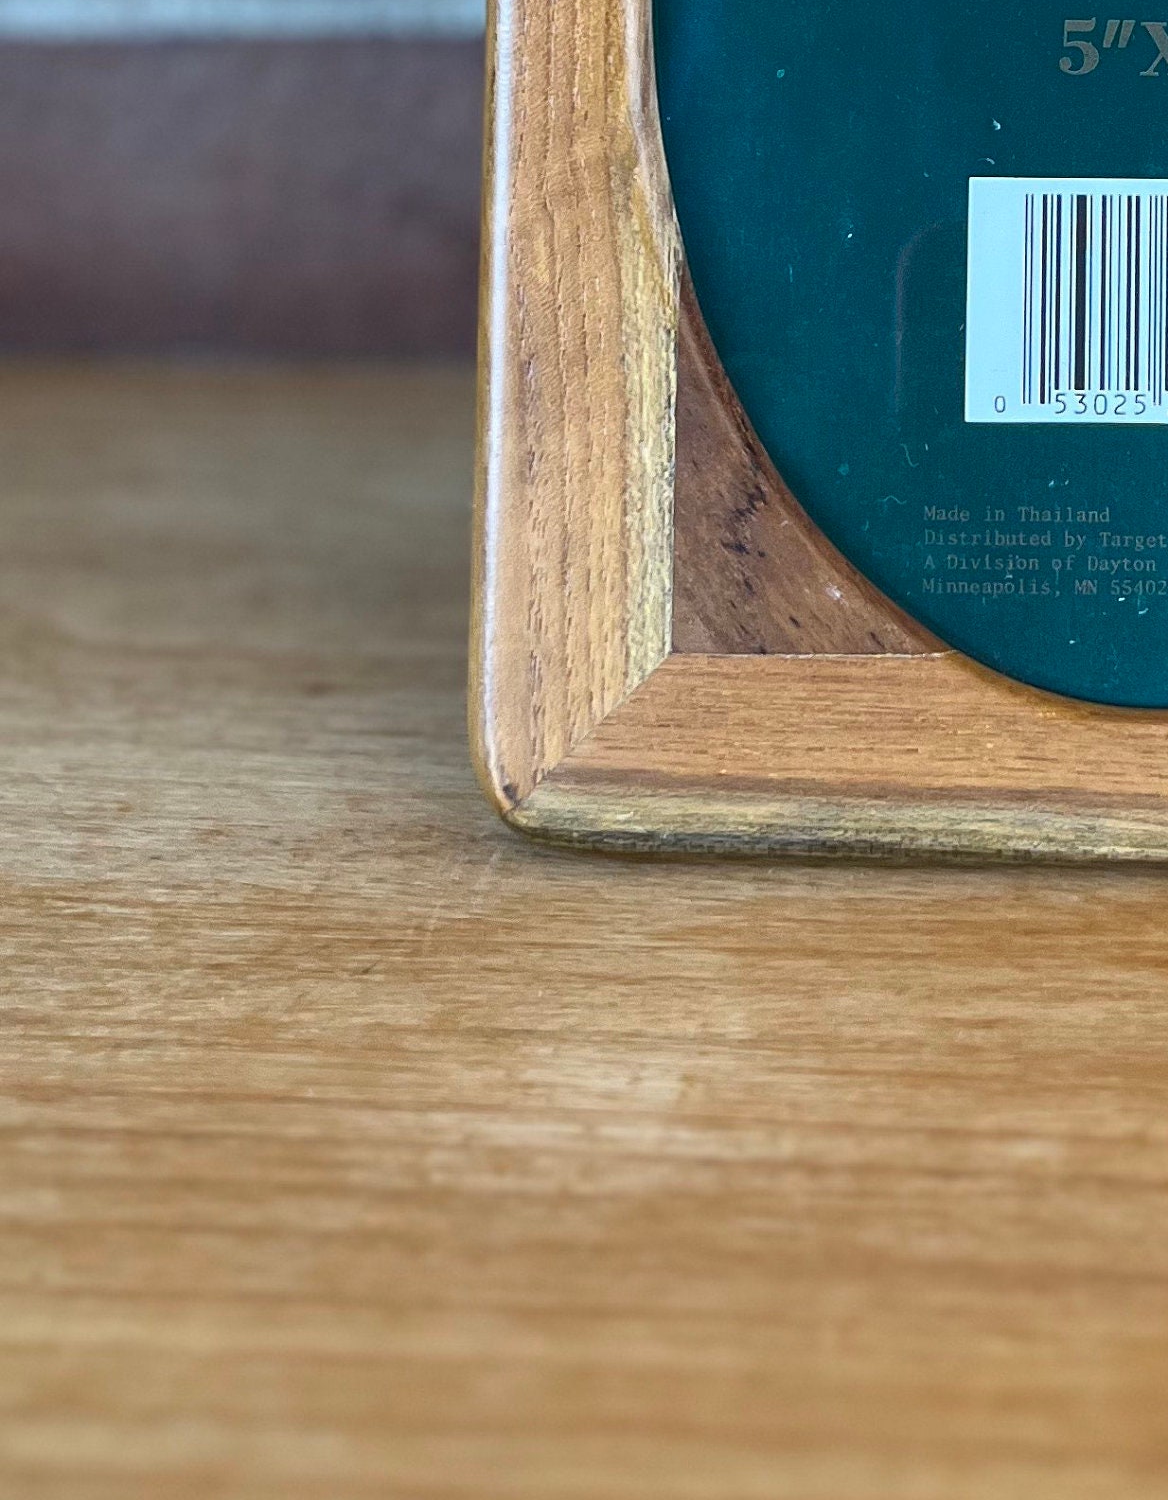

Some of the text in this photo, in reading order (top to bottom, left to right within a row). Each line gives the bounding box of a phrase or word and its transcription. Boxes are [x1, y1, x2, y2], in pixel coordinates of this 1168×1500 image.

[993, 394, 1007, 414] 0
[1053, 392, 1147, 416] 53025
[923, 505, 1111, 523] Made in Thailand
[924, 528, 1051, 547] Distributed
[1063, 530, 1086, 550] by
[1099, 531, 1167, 551] Target
[923, 554, 936, 570] A
[946, 554, 1040, 572] Division
[1051, 554, 1076, 572] of
[1087, 555, 1156, 575] Dayton
[921, 577, 1168, 598] Minneapolis, MN 55402
